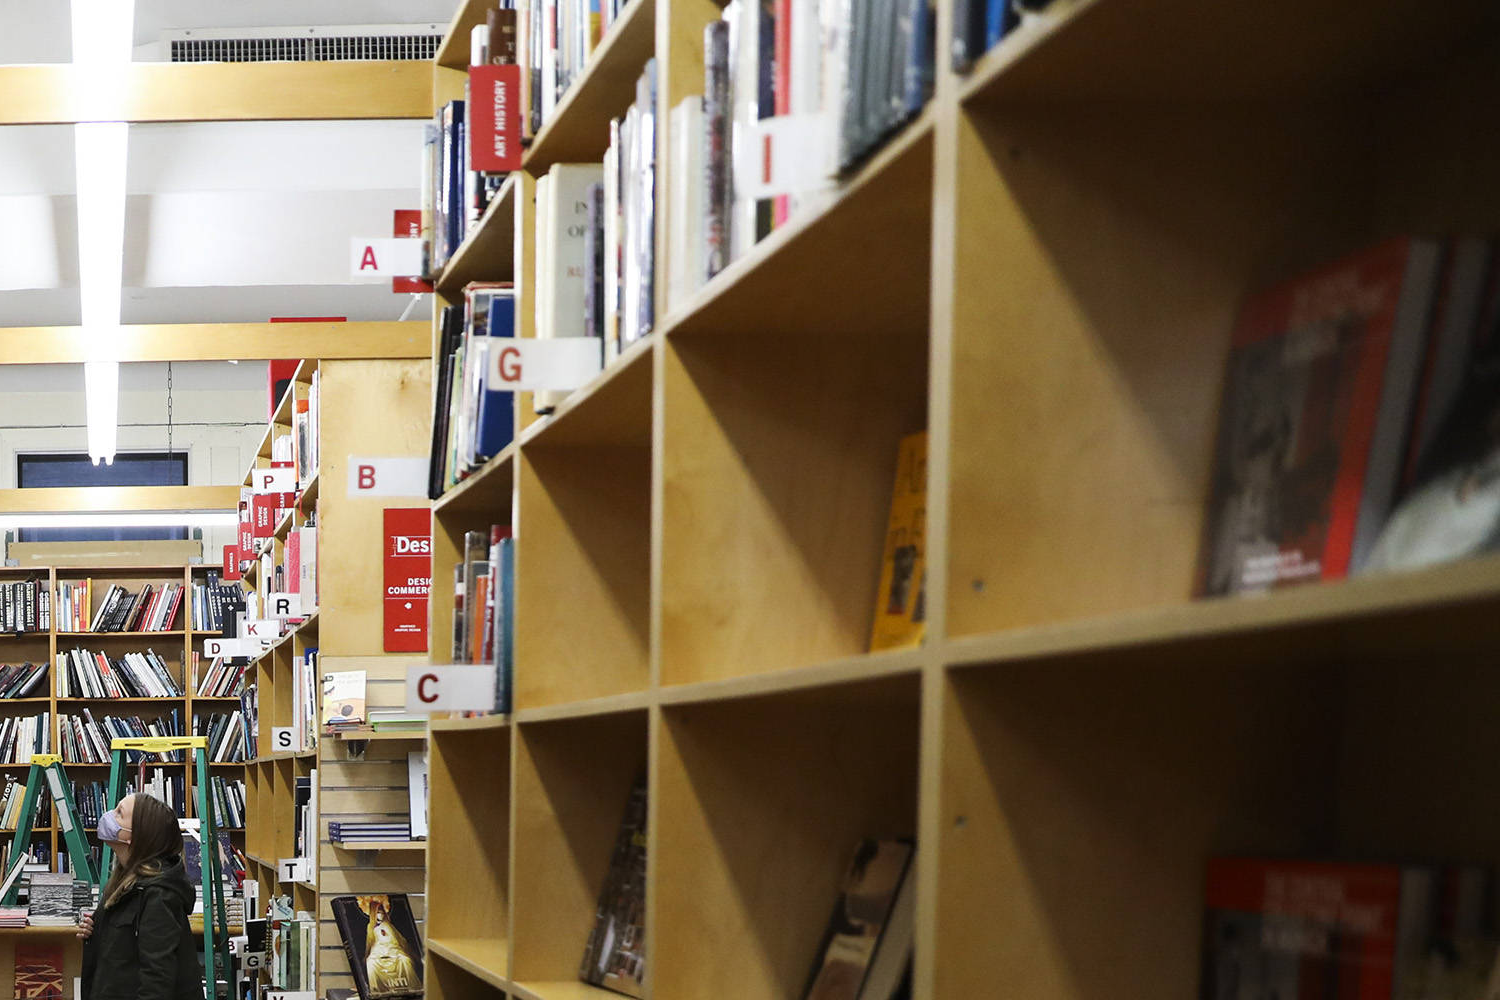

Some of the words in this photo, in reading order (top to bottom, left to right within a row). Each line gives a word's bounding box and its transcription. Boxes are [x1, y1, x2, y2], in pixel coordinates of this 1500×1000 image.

[495, 80, 506, 131] HISTORY
[495, 135, 506, 158] ART
[361, 246, 377, 270] A
[499, 347, 521, 382] G
[264, 476, 274, 489] P
[359, 466, 375, 489] B
[277, 599, 289, 614] R
[248, 624, 257, 635] K
[212, 643, 220, 654] D
[418, 674, 438, 703] C
[279, 731, 291, 746] S
[1, 782, 13, 801] GOYA
[285, 863, 298, 879] T
[247, 956, 259, 967] G
